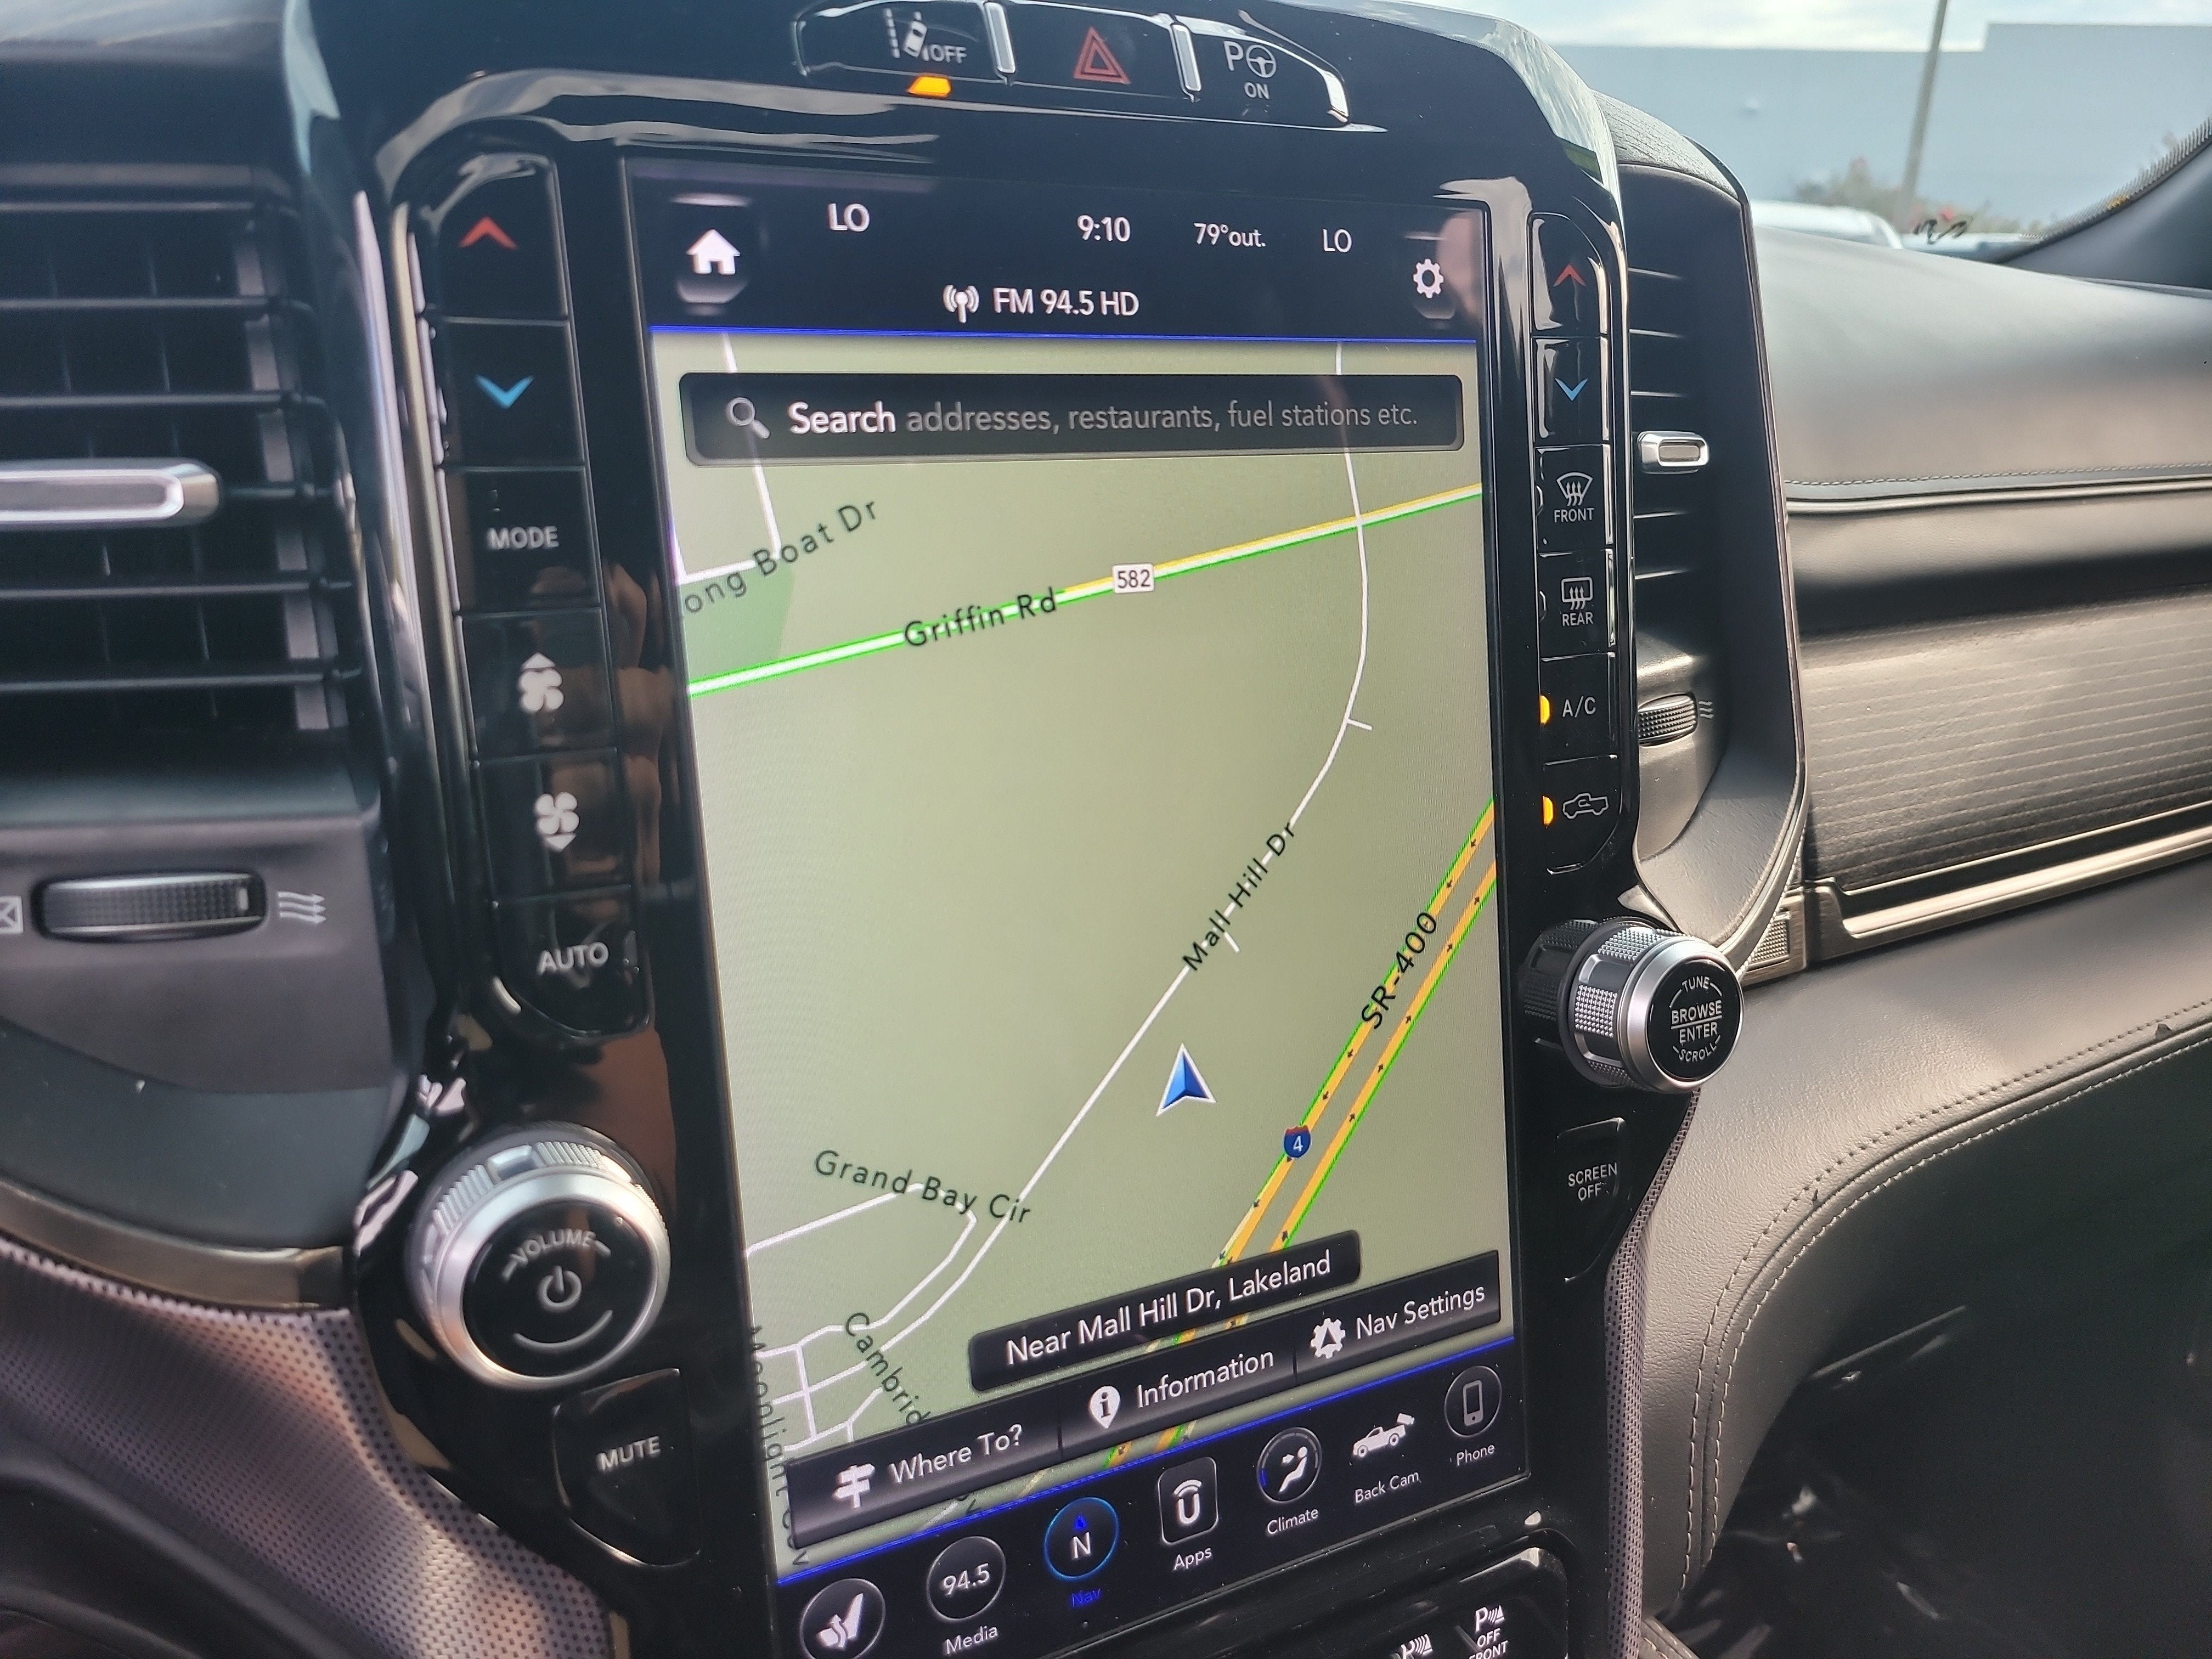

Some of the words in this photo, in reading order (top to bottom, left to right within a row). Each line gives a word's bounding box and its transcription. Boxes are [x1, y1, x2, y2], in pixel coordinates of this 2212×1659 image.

[930, 44, 967, 64] OFF
[1244, 82, 1269, 99] ON
[828, 203, 870, 233] LO
[1077, 215, 1131, 242] 9:10
[1323, 229, 1352, 252] LO
[994, 287, 1034, 314] FM
[1041, 289, 1094, 315] 94.5
[1101, 291, 1139, 317] HD
[788, 400, 896, 435] Search
[906, 402, 1059, 435] addresses,
[1069, 405, 1220, 432] restaurants,
[1229, 399, 1274, 427] fuel
[1282, 400, 1371, 427] stations
[1378, 404, 1418, 425] etc.
[1554, 507, 1595, 523] FRONT
[486, 525, 559, 550] MODE
[753, 523, 835, 576] Boat
[837, 498, 877, 533] Dr
[1117, 570, 1150, 590] 582
[905, 606, 1006, 647] Griffin
[1017, 586, 1057, 619] Rd
[1562, 612, 1594, 627] REAR
[1562, 696, 1596, 718] A/C
[1182, 909, 1231, 971] Mall
[1228, 857, 1268, 910] Hill
[1266, 822, 1295, 857] Dr
[538, 941, 609, 975] AUTO
[1361, 911, 1437, 1030] SR-400
[1681, 975, 1710, 990] TUNE
[1672, 1000, 1722, 1023] BROWSE
[1679, 1021, 1718, 1045] ENTER
[1678, 1042, 1718, 1063] SCROLL
[1293, 1135, 1303, 1152] 4
[814, 1149, 913, 1195] Grand
[922, 1176, 977, 1215] Bay
[989, 1193, 1032, 1224] Cir
[1568, 1162, 1618, 1187] SCREEN
[1578, 1183, 1602, 1201] OFF
[511, 1228, 597, 1265] VOLUME
[1005, 1327, 1071, 1366] Near
[1077, 1301, 1131, 1346] Mall
[1138, 1290, 1178, 1329] Hill
[1186, 1283, 1223, 1315] Dr,
[1228, 1250, 1331, 1301] Lakeland
[1356, 1313, 1398, 1340] Nav
[1403, 1284, 1486, 1323] Settings
[1136, 1350, 1274, 1408] Information
[596, 1435, 661, 1472] MUTE
[890, 1443, 973, 1484] Where
[977, 1424, 1023, 1455] To?
[1455, 1443, 1495, 1467] Phone
[1355, 1481, 1386, 1504] Back
[1390, 1471, 1420, 1492] Cam
[1266, 1507, 1319, 1536] Climate
[1071, 1531, 1092, 1560] N
[1173, 1547, 1212, 1571] Apps
[942, 1564, 990, 1595] 94.5
[1071, 1587, 1102, 1608] Nav
[944, 1624, 998, 1655] Media
[1477, 1628, 1501, 1647] OFF
